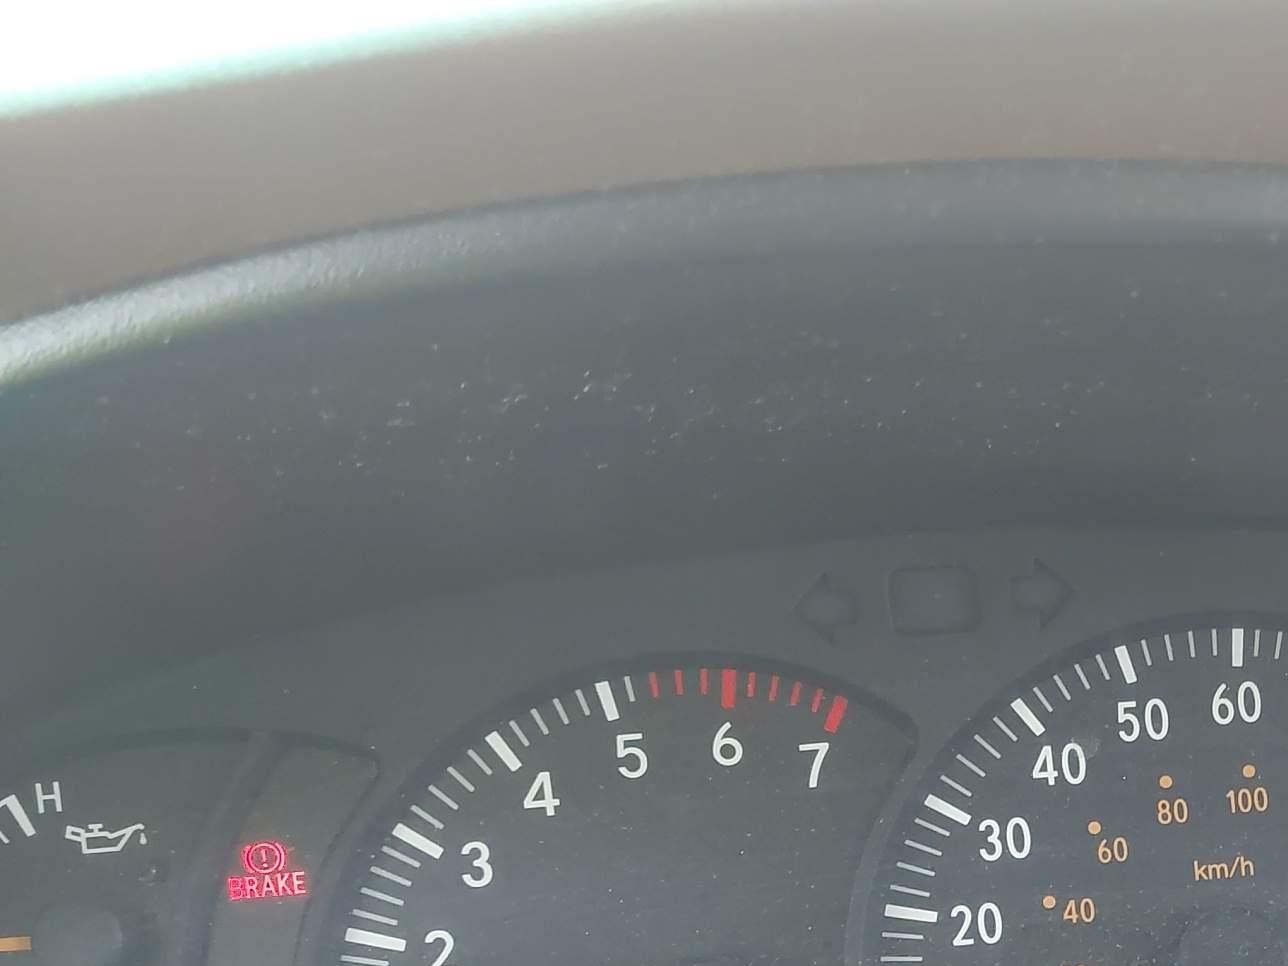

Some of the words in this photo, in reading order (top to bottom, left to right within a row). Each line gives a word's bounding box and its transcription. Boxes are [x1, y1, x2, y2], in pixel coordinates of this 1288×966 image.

[1117, 698, 1169, 742] 50
[1212, 680, 1262, 725] 60
[616, 732, 648, 779] 5
[712, 721, 744, 766] 6
[798, 742, 830, 789] 7
[1032, 742, 1087, 786] 40
[34, 781, 63, 814] H
[523, 771, 561, 817] 4
[1157, 798, 1188, 825] 80
[1226, 787, 1268, 814] 100
[978, 816, 1031, 862] 30
[1098, 837, 1128, 864] 60
[226, 871, 307, 901] BRAKE
[460, 841, 493, 888] 3
[1193, 856, 1254, 881] km/h
[950, 902, 1003, 947] 20
[1063, 898, 1095, 924] 40
